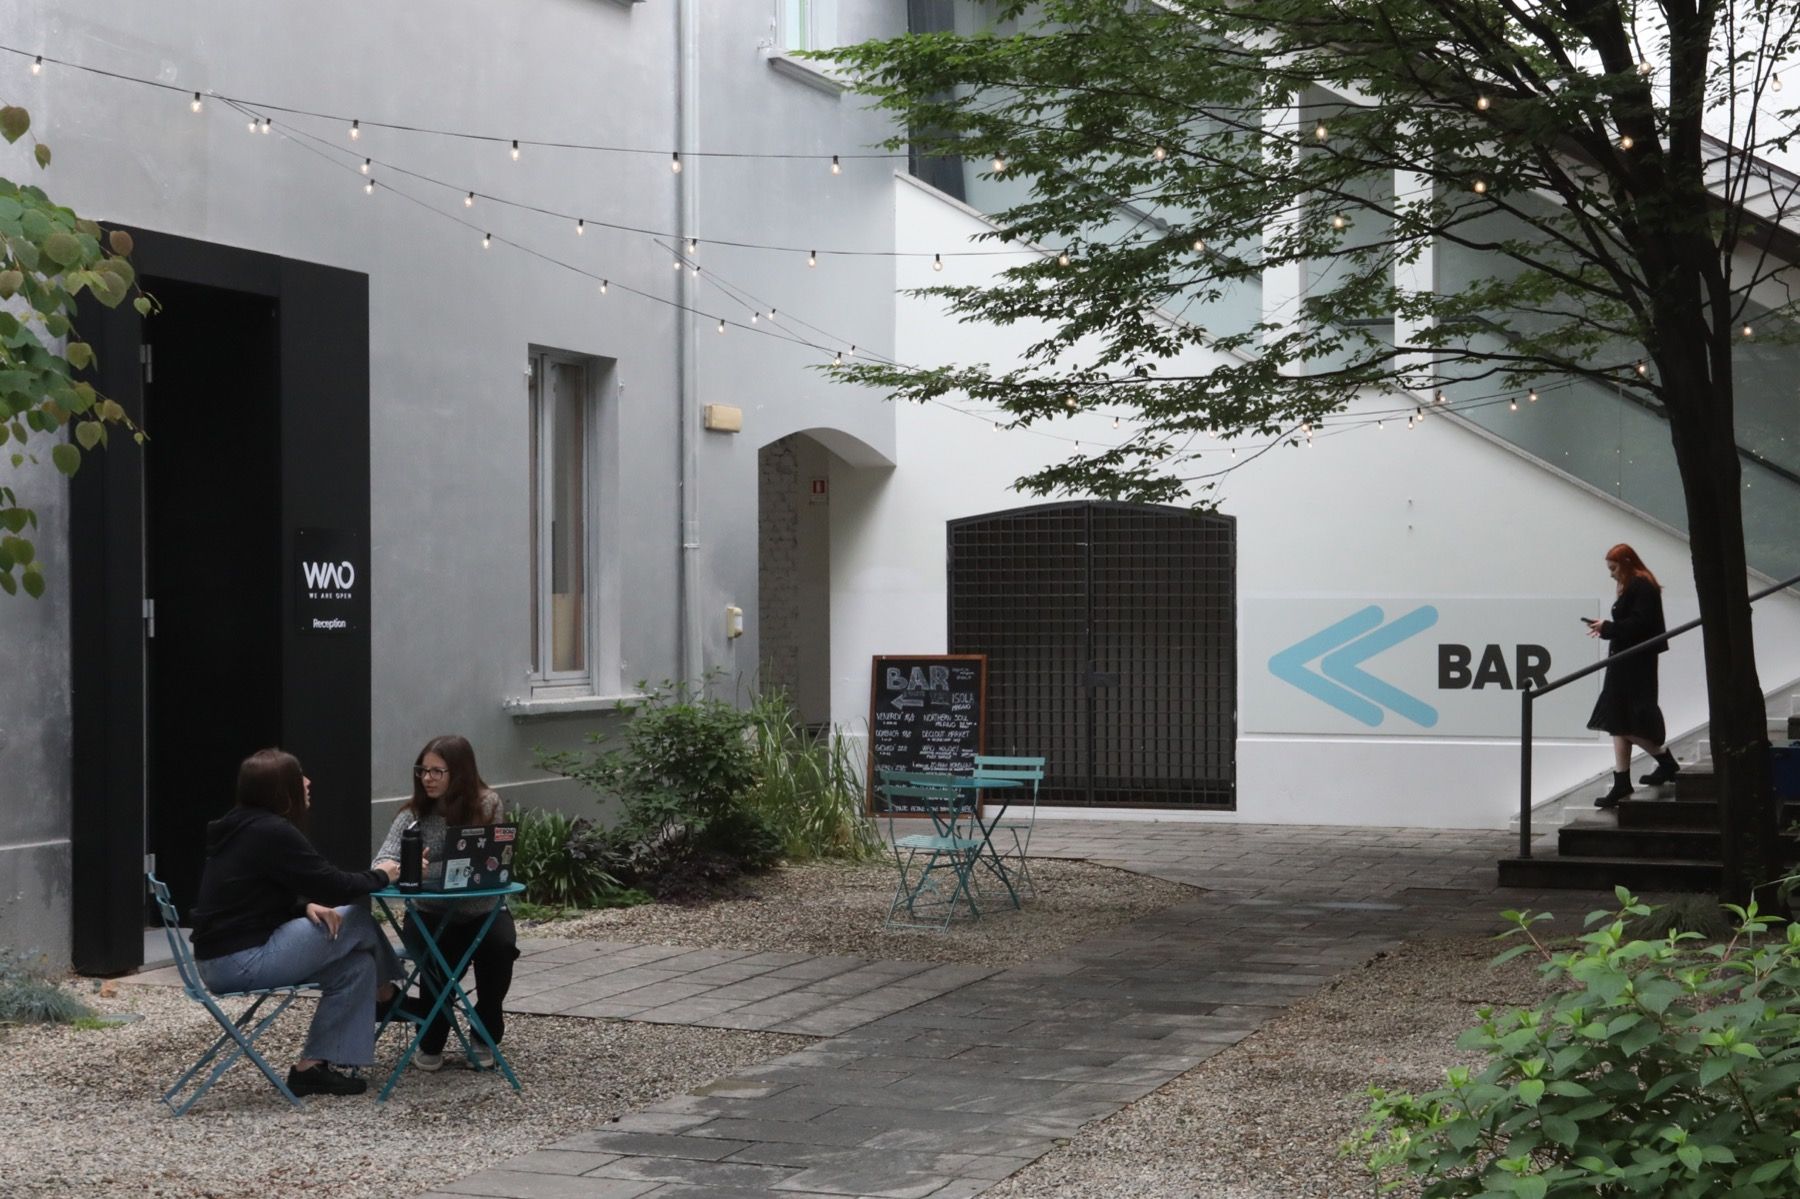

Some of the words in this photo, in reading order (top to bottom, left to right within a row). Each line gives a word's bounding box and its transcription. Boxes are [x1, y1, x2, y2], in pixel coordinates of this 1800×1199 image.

[302, 560, 355, 590] WAO
[313, 618, 346, 630] Reception
[886, 665, 950, 691] BAR
[1438, 643, 1552, 690] BAR
